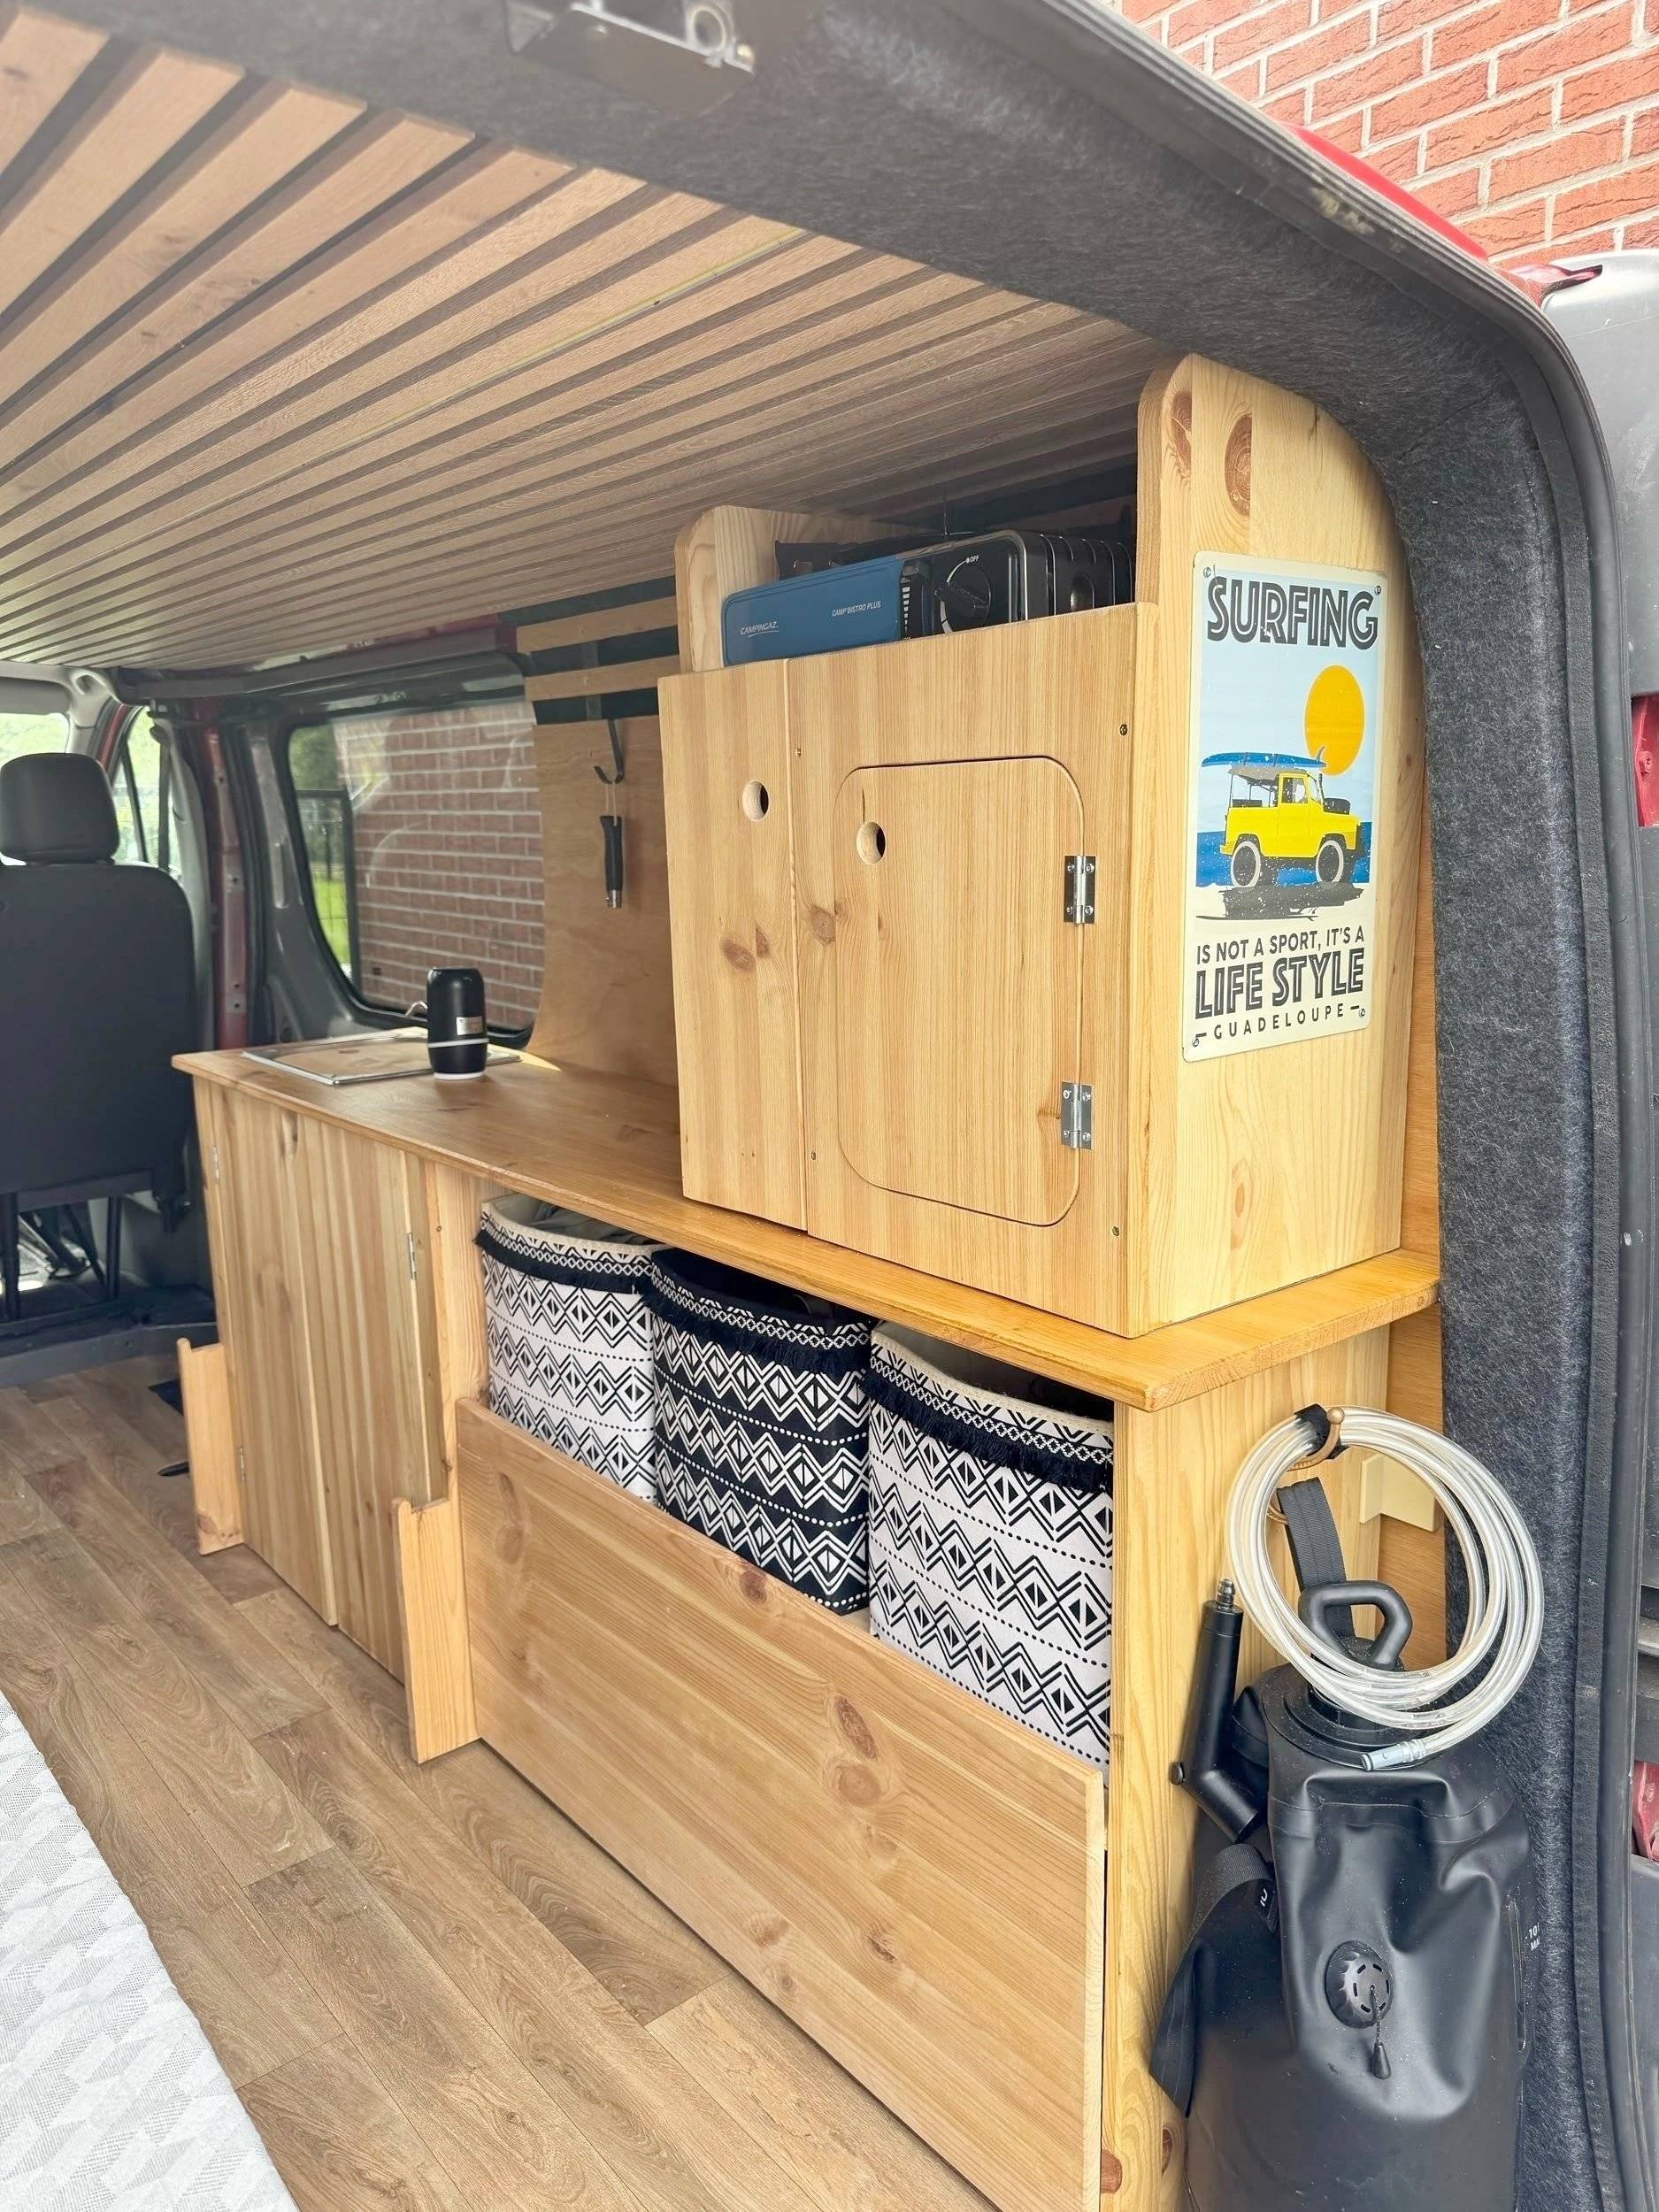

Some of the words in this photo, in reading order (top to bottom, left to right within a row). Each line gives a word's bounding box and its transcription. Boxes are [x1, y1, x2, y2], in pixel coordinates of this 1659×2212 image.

[866, 601, 881, 611] PLUS
[1207, 576, 1379, 650] SURFING
[1196, 944, 1210, 965] IS
[1216, 939, 1249, 962] NOT
[1253, 937, 1264, 957] A
[1269, 930, 1321, 954] SPORT,
[1326, 926, 1351, 947] IT'S
[1355, 926, 1364, 942] A
[1194, 961, 1263, 1020] LIFE
[1271, 947, 1365, 1007] STYLE
[1213, 1002, 1344, 1040] GUADELOUPE
